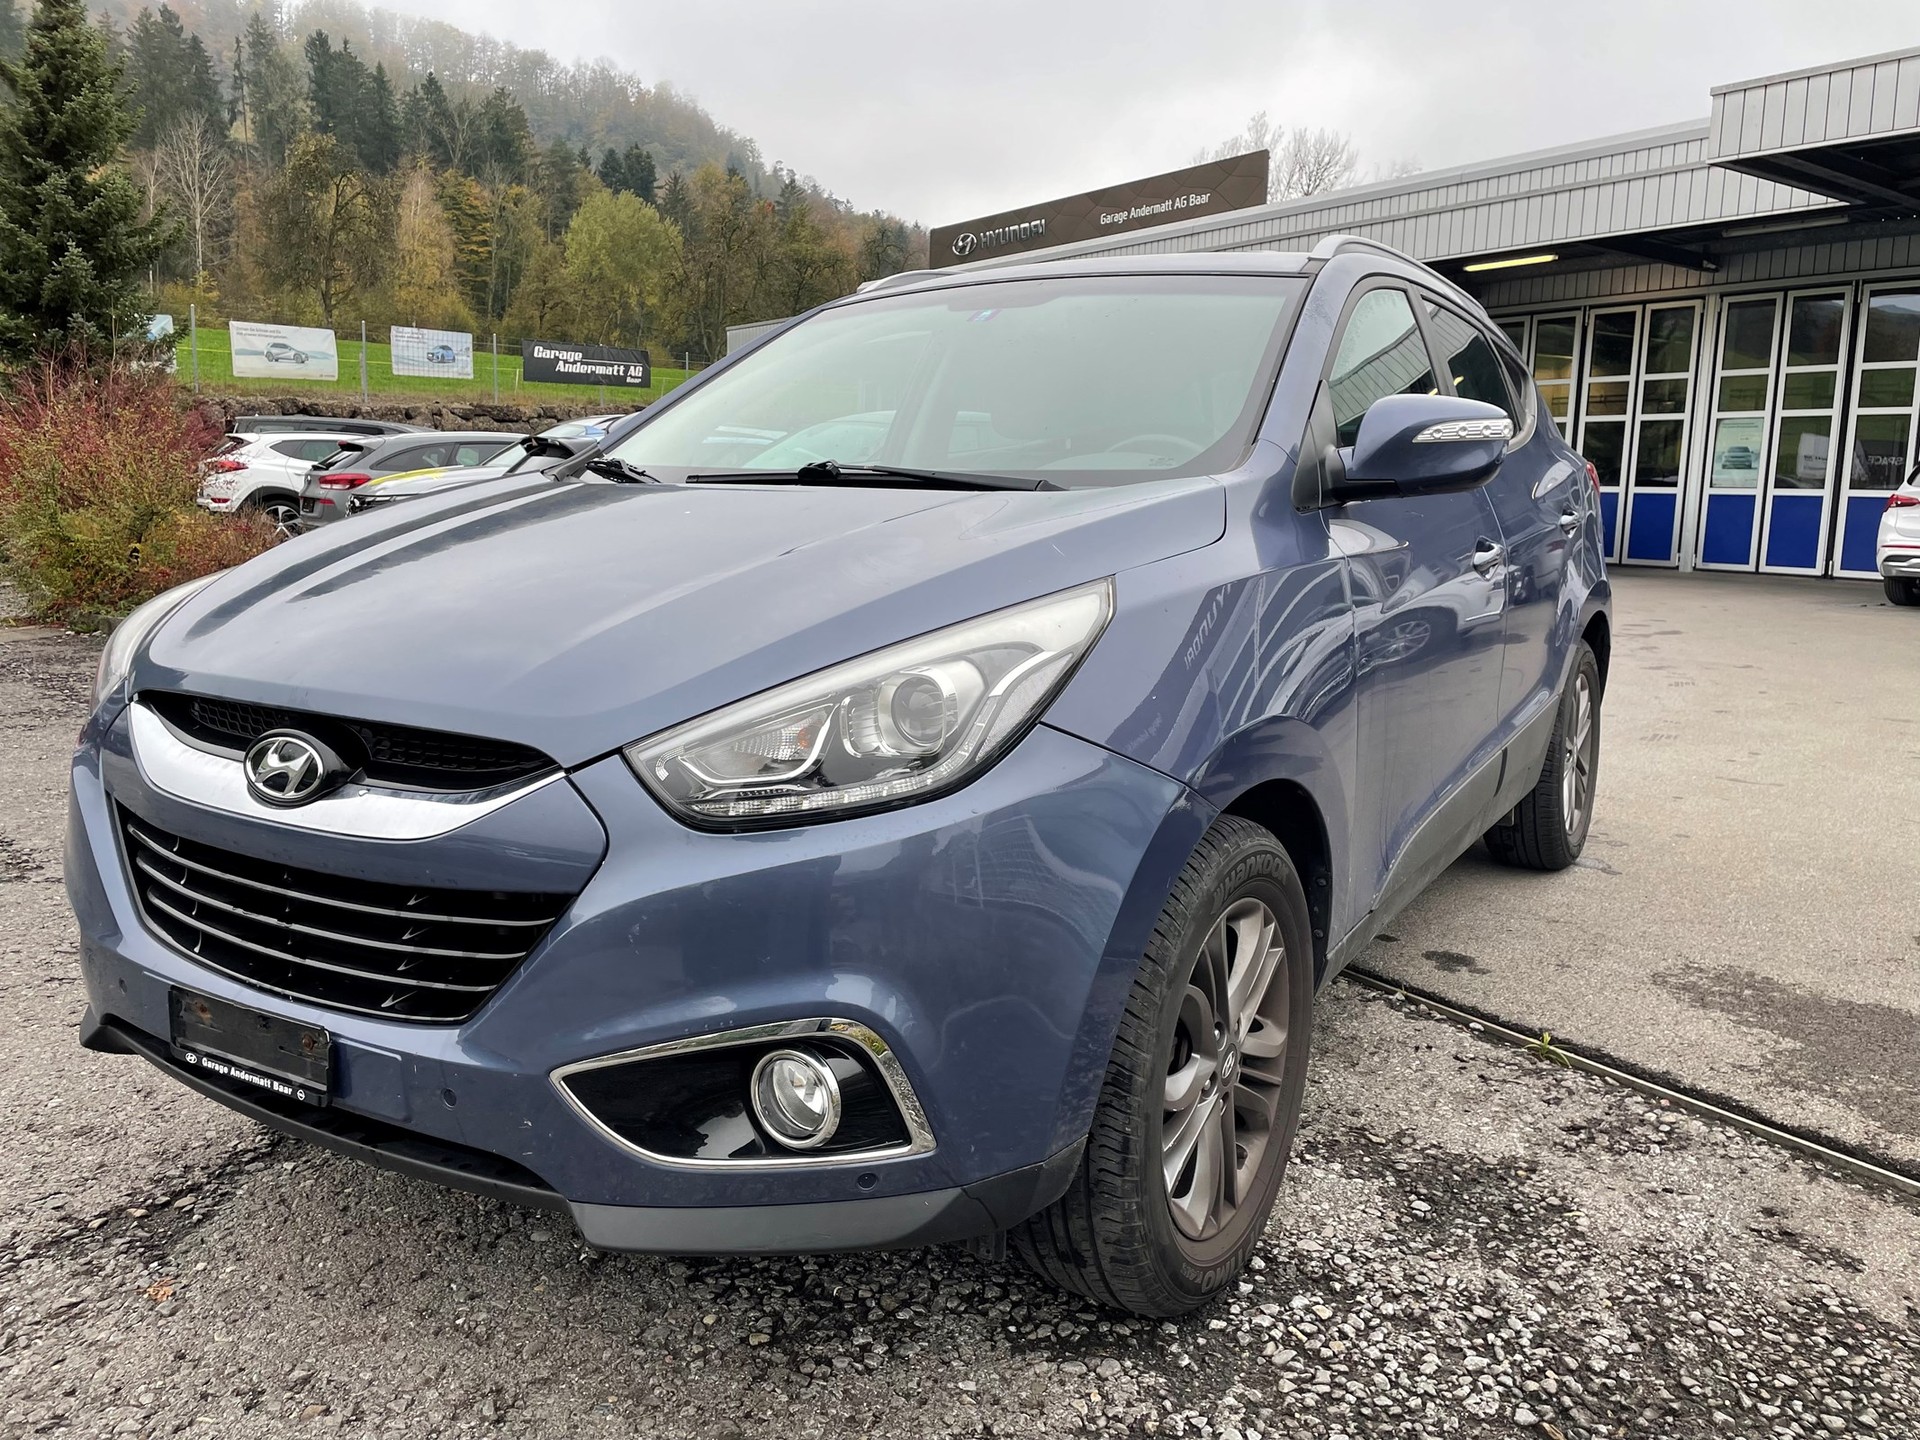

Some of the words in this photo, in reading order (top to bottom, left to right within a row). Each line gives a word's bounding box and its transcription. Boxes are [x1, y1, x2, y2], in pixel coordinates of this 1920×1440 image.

[1100, 211, 1128, 225] Garage
[1129, 197, 1173, 219] Andermatt
[1174, 195, 1187, 209] AG
[1189, 192, 1211, 206] Baar
[980, 218, 1046, 249] HYUNDAI
[533, 345, 583, 362] Garage
[555, 360, 625, 376] Andermatt
[627, 366, 643, 377] AG
[201, 1057, 228, 1074] Garage
[230, 1066, 271, 1088] Andermatt
[273, 1080, 293, 1095] Baar
